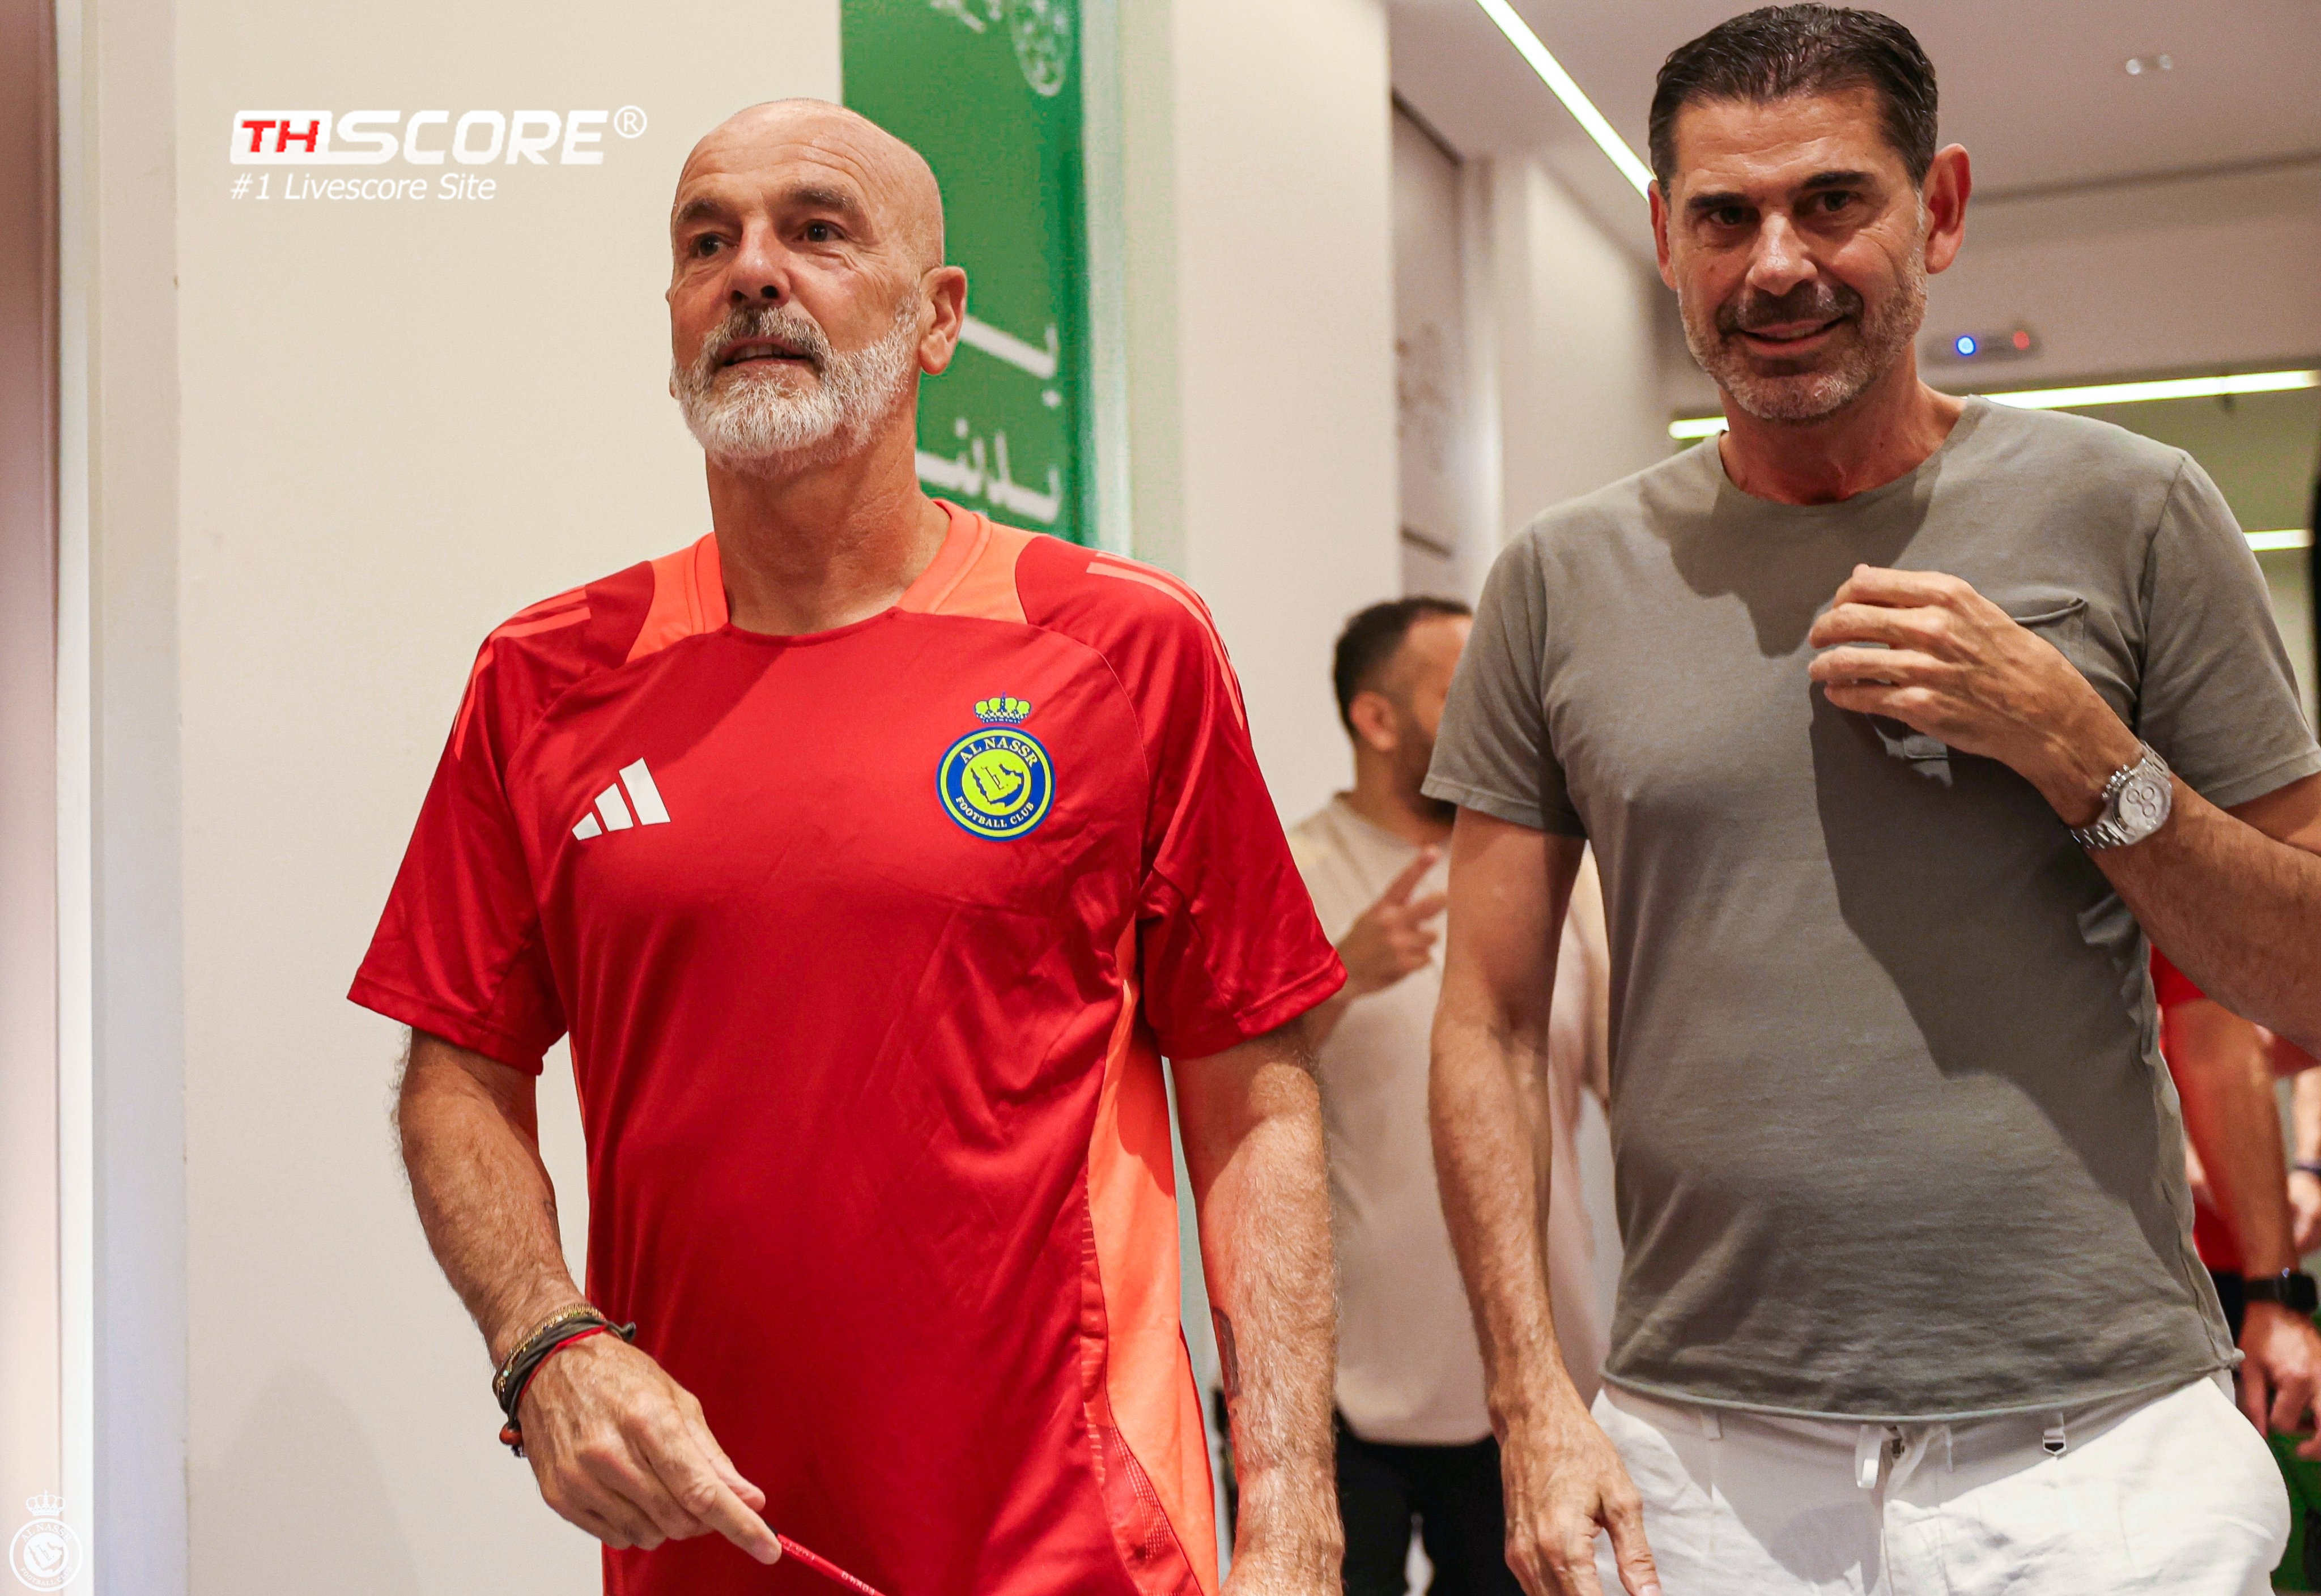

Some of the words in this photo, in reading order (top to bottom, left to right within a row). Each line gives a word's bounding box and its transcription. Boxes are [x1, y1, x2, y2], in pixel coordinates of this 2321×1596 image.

[960, 743, 981, 763] AL
[984, 738, 1038, 767] NASSR
[955, 797, 1007, 827] FOOTBALL
[1010, 802, 1034, 824] CLUB
